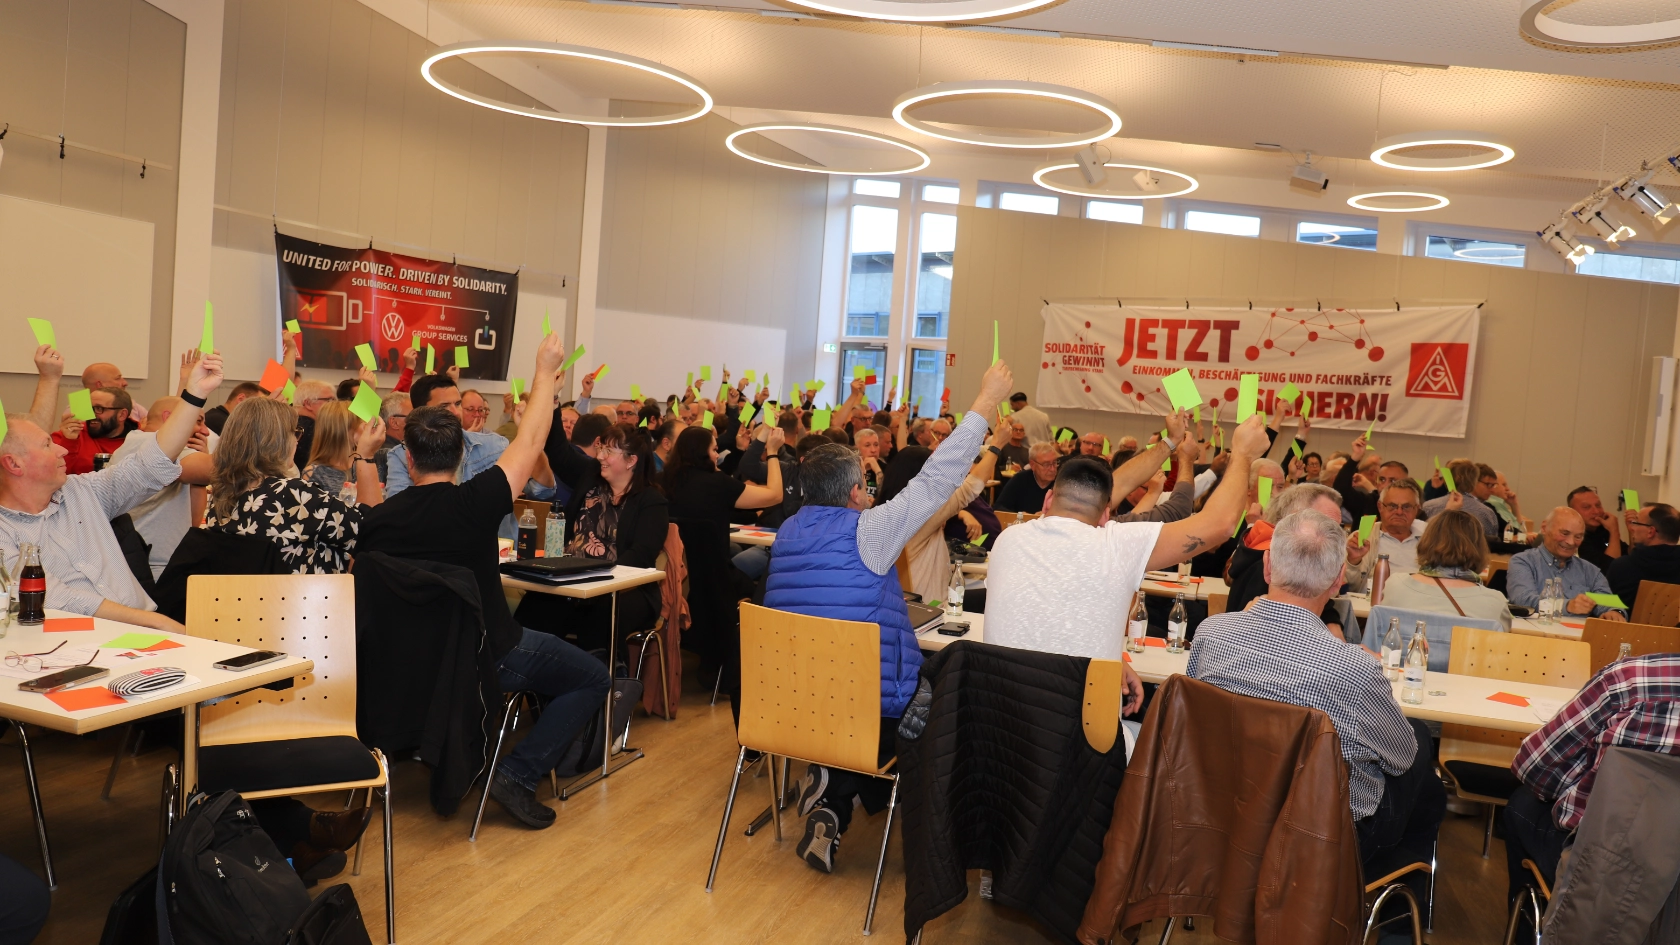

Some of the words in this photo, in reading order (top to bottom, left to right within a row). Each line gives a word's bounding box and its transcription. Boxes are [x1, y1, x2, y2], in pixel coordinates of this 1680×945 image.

[283, 249, 332, 271] UNITED
[332, 260, 352, 272] FOR
[352, 260, 396, 279] POWER.
[399, 268, 437, 285] DRIVEN
[437, 274, 450, 286] BY
[452, 276, 508, 295] SOLIDARITY.
[351, 278, 399, 293] SOLIDARISCH.
[400, 285, 424, 296] STARK.
[425, 289, 452, 300] VEREINT.
[412, 330, 437, 339] GROUP
[438, 332, 468, 343] SERVICES
[1116, 317, 1240, 367] JETZT
[1044, 342, 1106, 356] SOLIDARITÄT
[1062, 355, 1105, 368] GEWINNT
[1289, 373, 1313, 384] UND
[1315, 373, 1392, 386] FACHKRÄFTE
